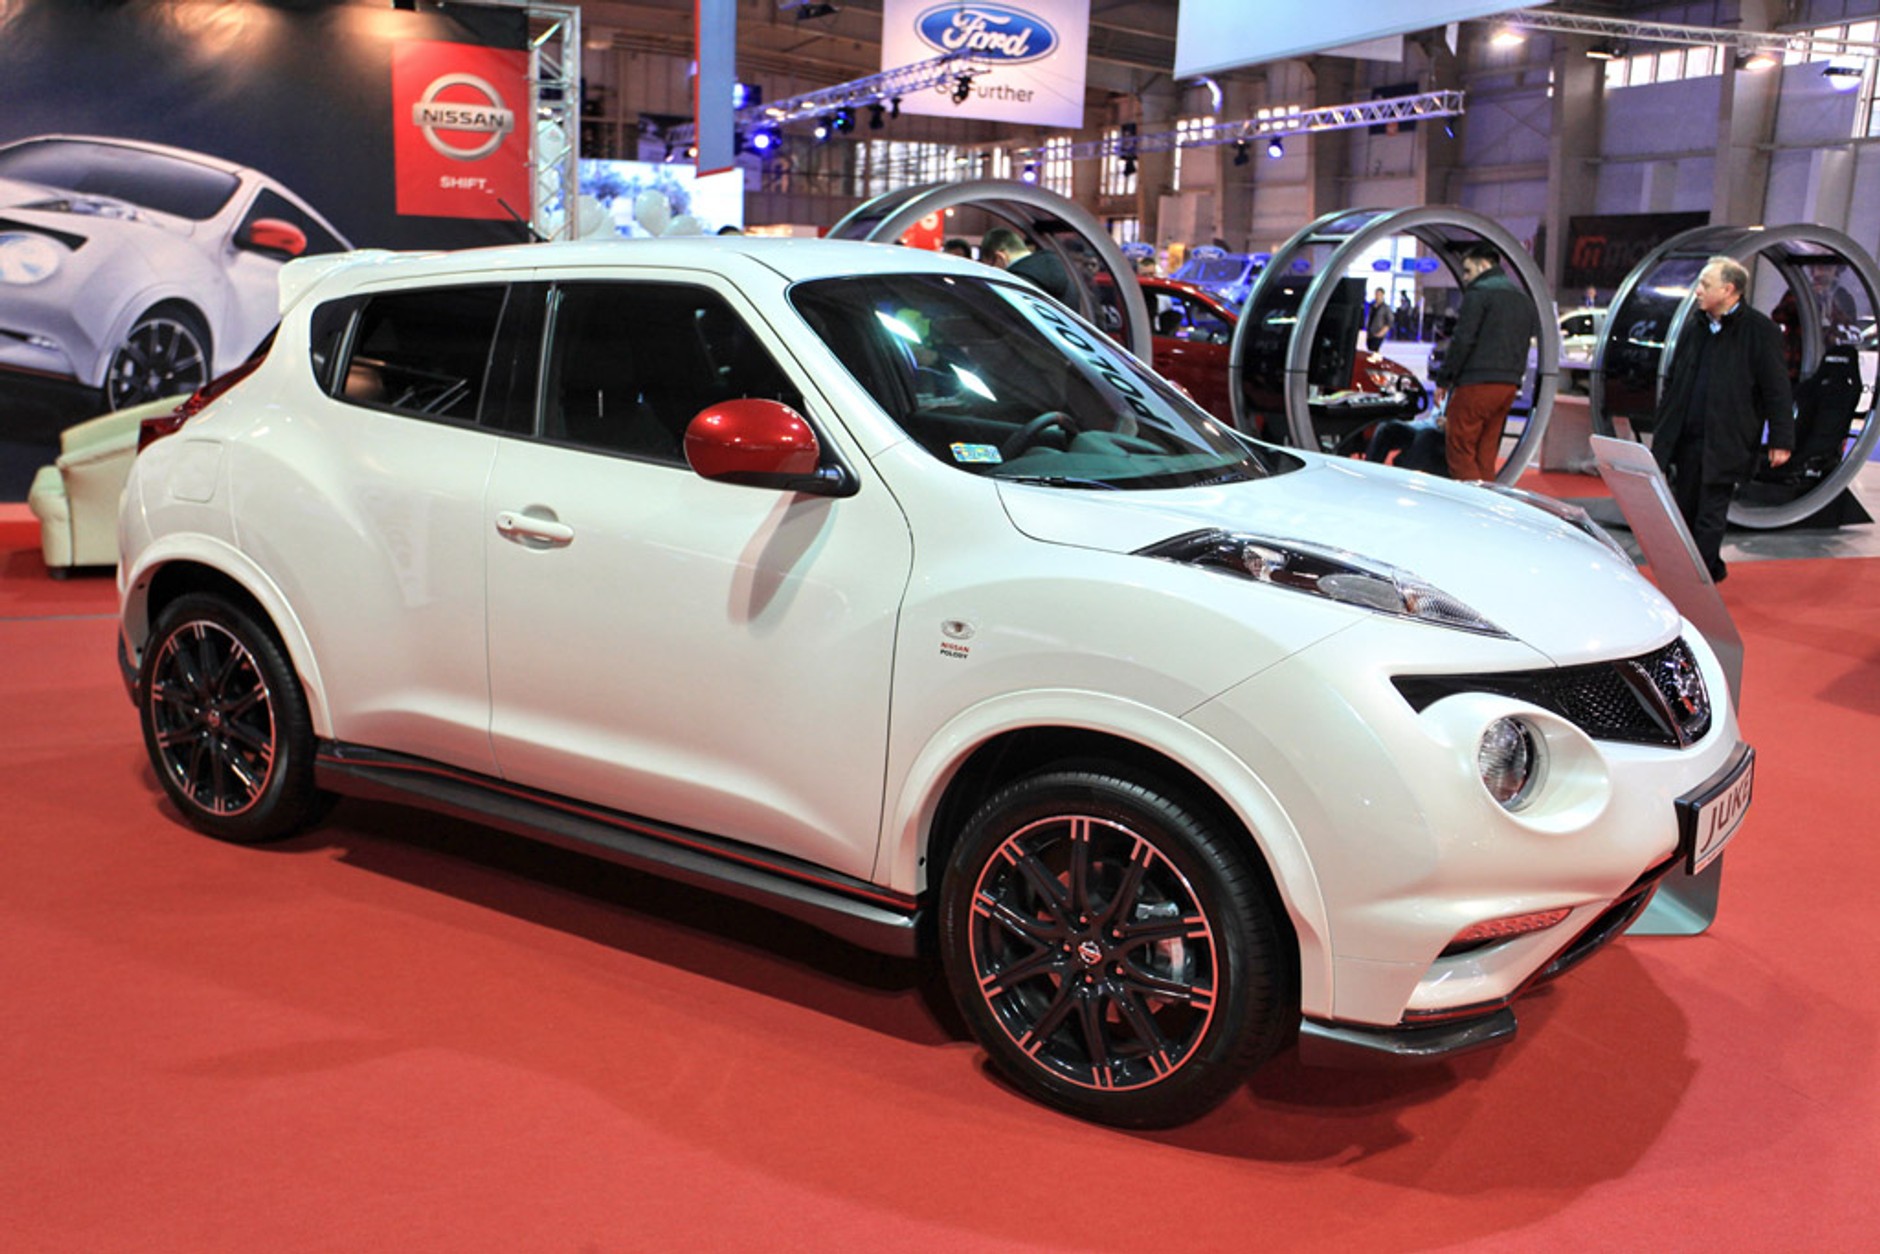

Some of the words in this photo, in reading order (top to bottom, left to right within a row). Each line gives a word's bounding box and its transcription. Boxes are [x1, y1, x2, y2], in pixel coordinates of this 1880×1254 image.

[942, 9, 1033, 57] Ford
[966, 83, 1034, 103] urther
[421, 109, 504, 128] NISSAN
